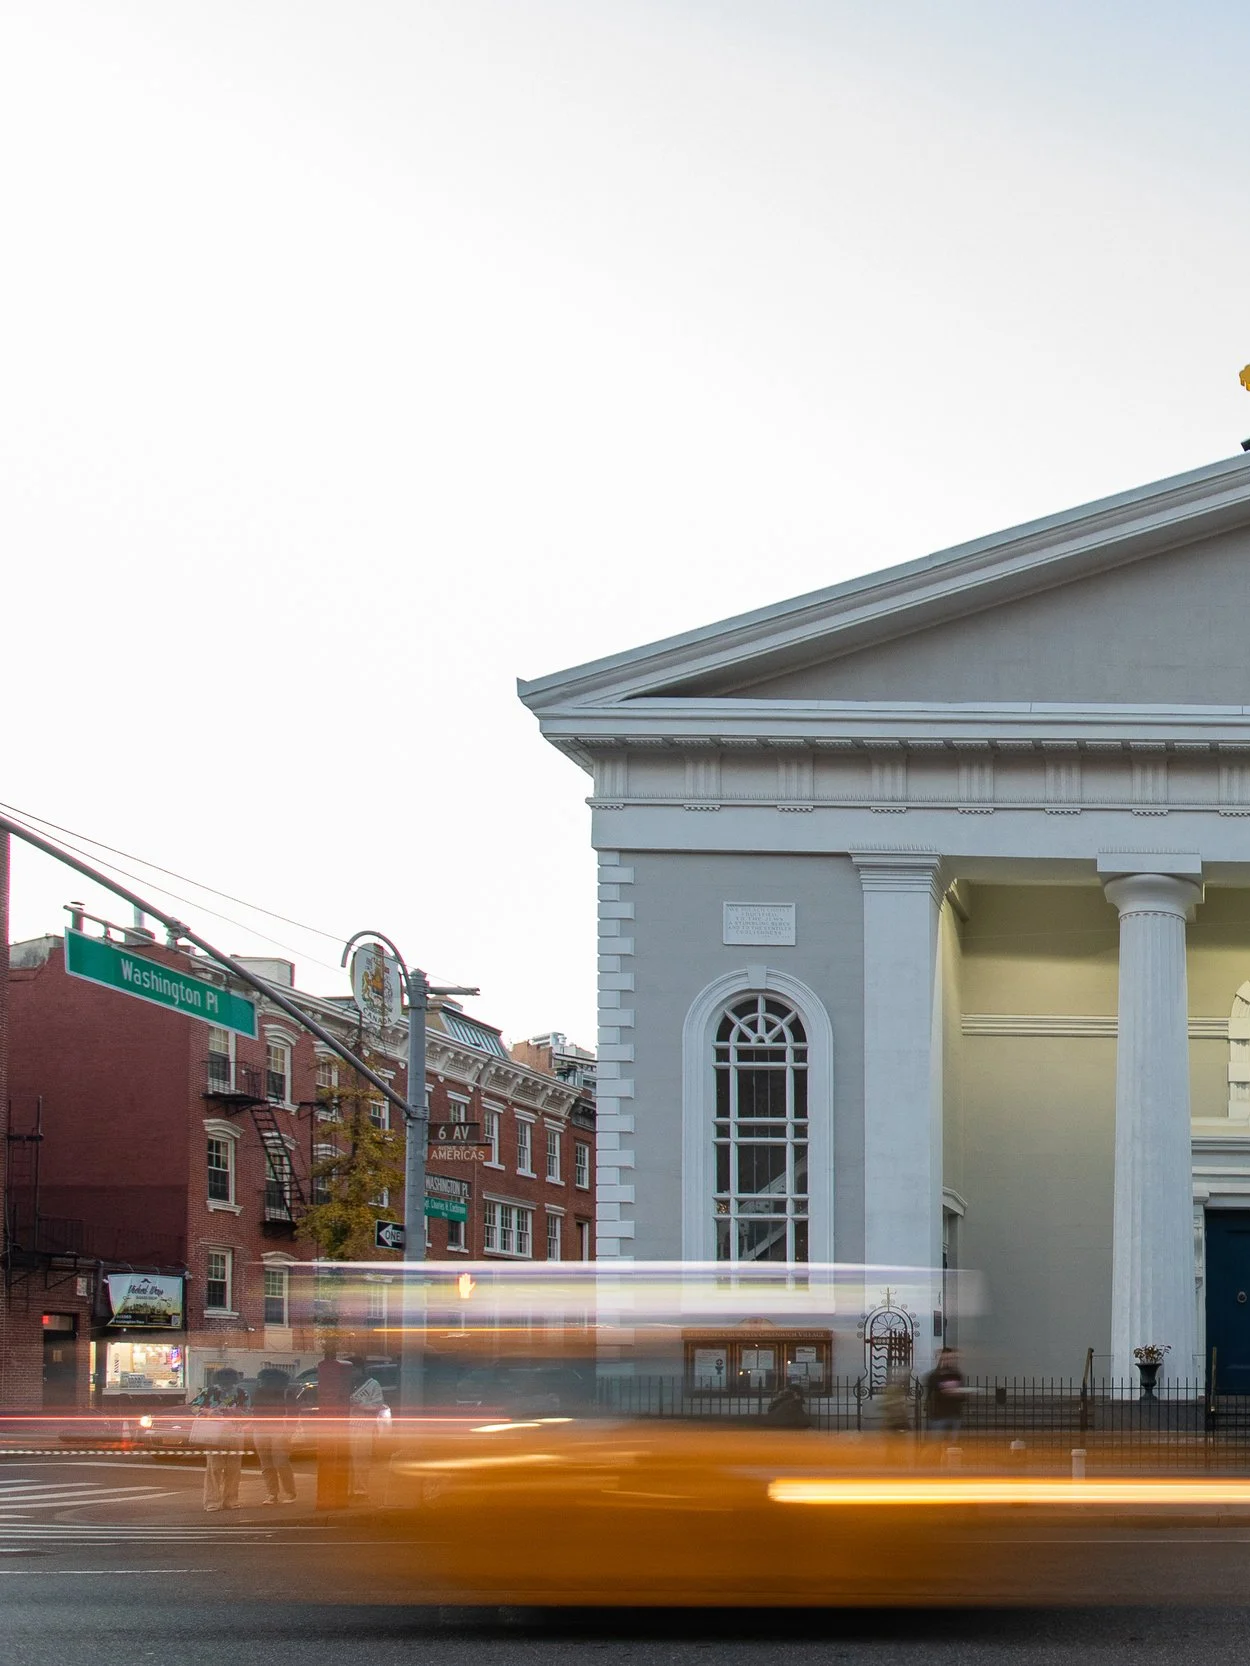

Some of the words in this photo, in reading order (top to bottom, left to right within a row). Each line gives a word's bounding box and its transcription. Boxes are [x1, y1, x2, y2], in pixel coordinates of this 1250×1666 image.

[121, 958, 201, 1007] Washington
[206, 991, 219, 1013] Pl
[439, 1126, 446, 1139] 6
[453, 1126, 469, 1139] AV
[430, 1150, 485, 1160] AMERICAS
[426, 1176, 460, 1195] WASHINGTON
[462, 1183, 469, 1197] PL
[385, 1230, 401, 1242] ONE
